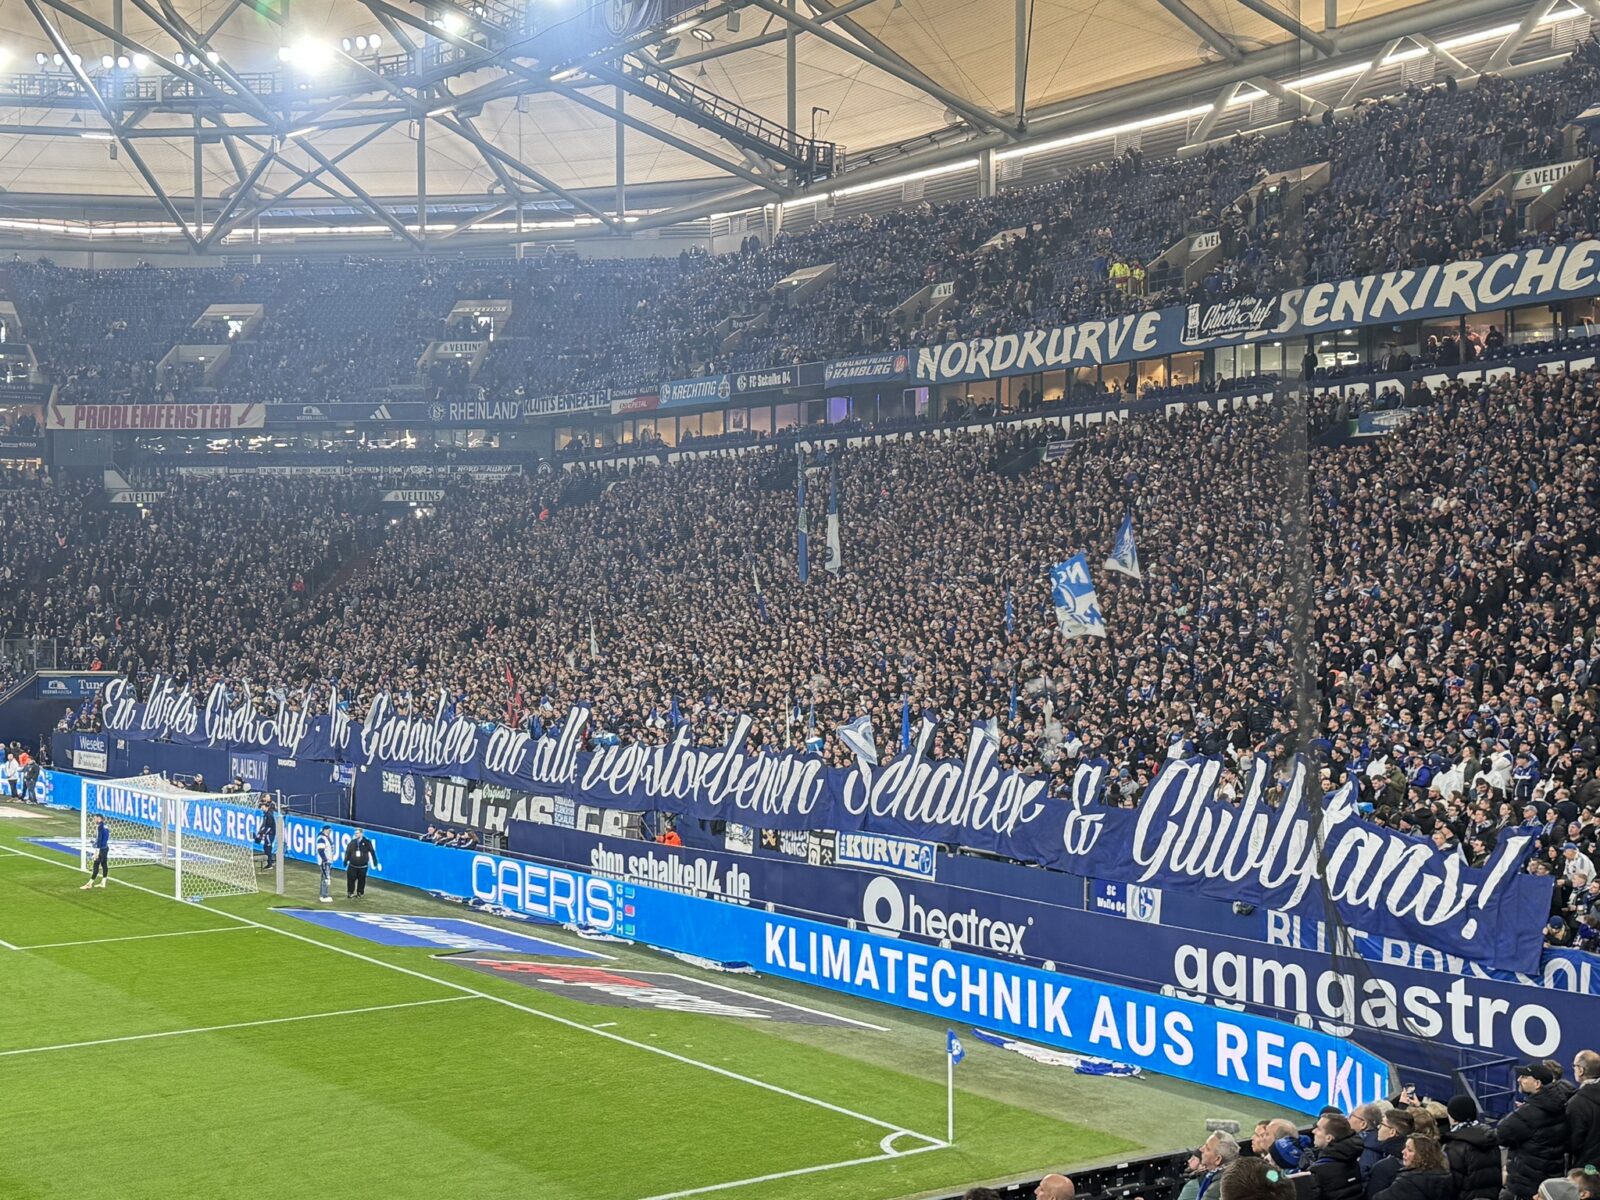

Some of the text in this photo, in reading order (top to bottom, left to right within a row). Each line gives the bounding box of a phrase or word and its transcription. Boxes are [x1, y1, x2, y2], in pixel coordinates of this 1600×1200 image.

[915, 311, 1162, 382] NORDKURVE
[782, 371, 791, 384] 04
[832, 364, 892, 379] HAMBURG
[74, 405, 232, 429] PROBLEMFENSTER
[449, 401, 519, 421] RHEINLAND
[401, 491, 440, 501] VELTINS
[79, 735, 105, 752] Weseke
[361, 687, 479, 766] Gedenken
[581, 714, 825, 815] verstorbenen
[843, 717, 1046, 839] Schalker
[1063, 763, 1106, 855] &
[193, 804, 222, 836] AUS
[846, 834, 920, 871] KURVE
[590, 842, 750, 906] shop.schalke04.de
[1106, 884, 1117, 896] SC
[471, 854, 615, 931] CAERIS
[1115, 900, 1126, 913] 04
[909, 894, 1026, 957] heatrex
[765, 922, 1073, 1038] KLIMATECHNIK
[1089, 995, 1194, 1066] AUS
[1173, 943, 1562, 1059] ggmgastro
